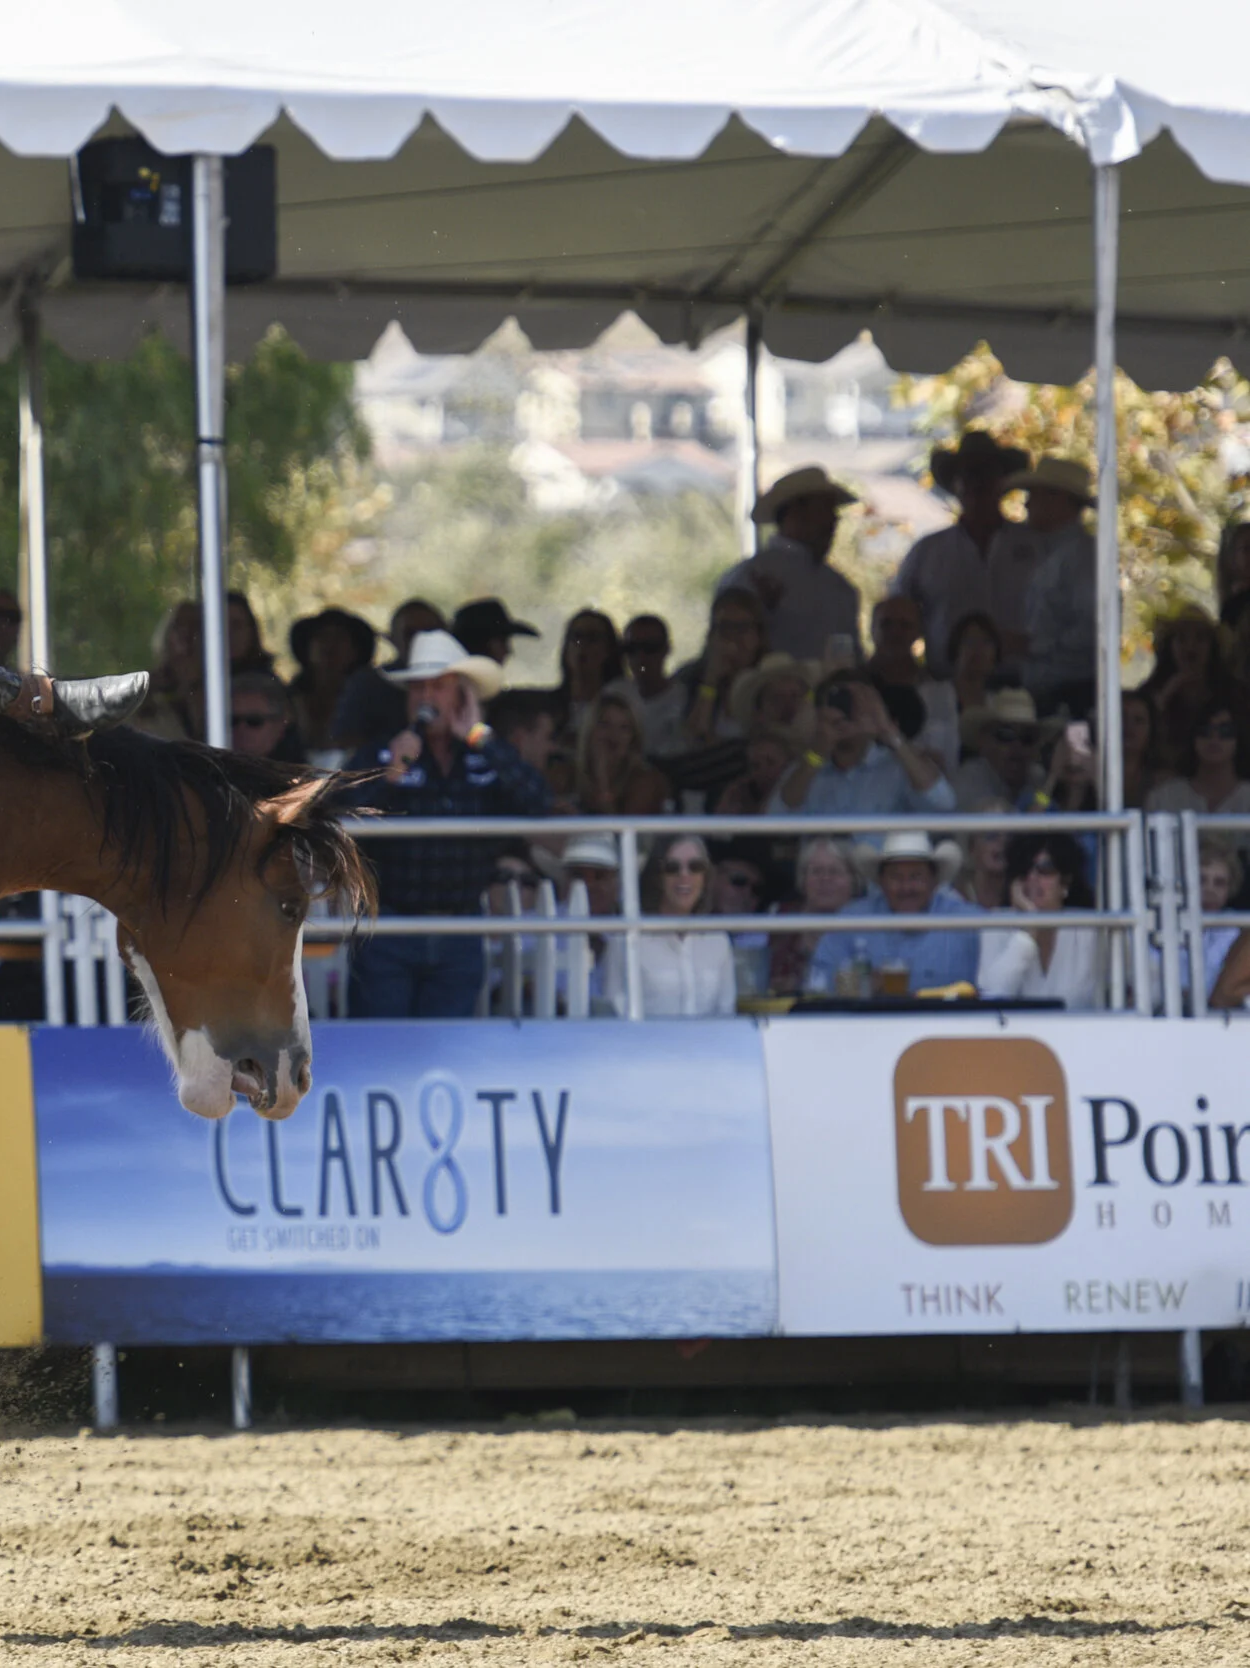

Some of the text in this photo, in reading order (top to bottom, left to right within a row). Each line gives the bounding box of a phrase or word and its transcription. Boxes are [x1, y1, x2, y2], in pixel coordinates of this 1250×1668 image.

[905, 1095, 1059, 1191] TRI
[901, 1282, 1004, 1316] THINK
[1064, 1280, 1188, 1314] RENEW
